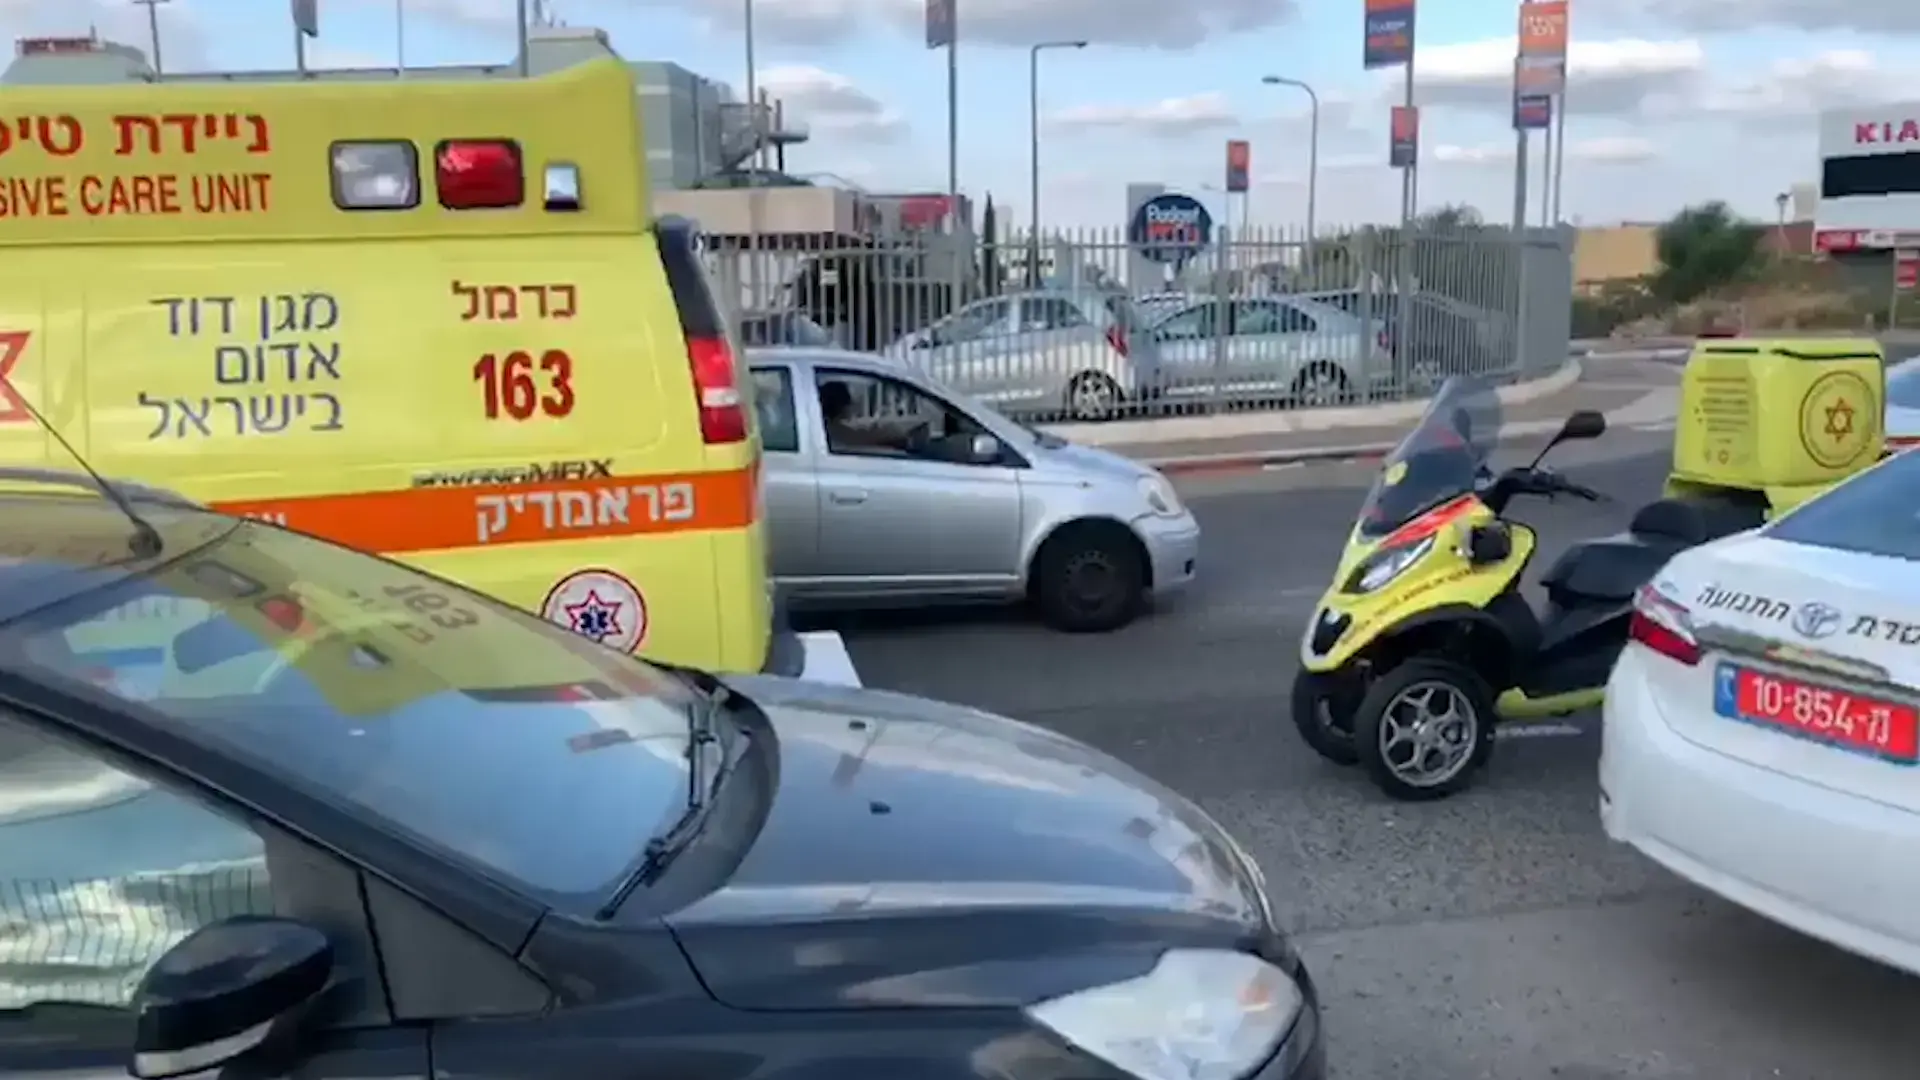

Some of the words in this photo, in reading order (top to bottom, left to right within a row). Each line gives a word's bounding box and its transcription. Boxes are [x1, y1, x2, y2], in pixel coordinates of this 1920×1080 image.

[0, 113, 84, 157] טי
[112, 112, 271, 155] ניידת
[1855, 120, 1920, 144] KIA
[80, 174, 182, 216] CARE
[192, 173, 272, 213] UNIT
[148, 296, 235, 336] דוד
[254, 293, 339, 340] מגן
[451, 279, 576, 321] כרמל
[215, 342, 341, 385] אדום
[472, 349, 576, 422] 163
[137, 391, 344, 441] בישראל
[475, 481, 695, 543] פראמדיק
[1696, 586, 1790, 622] התנועה
